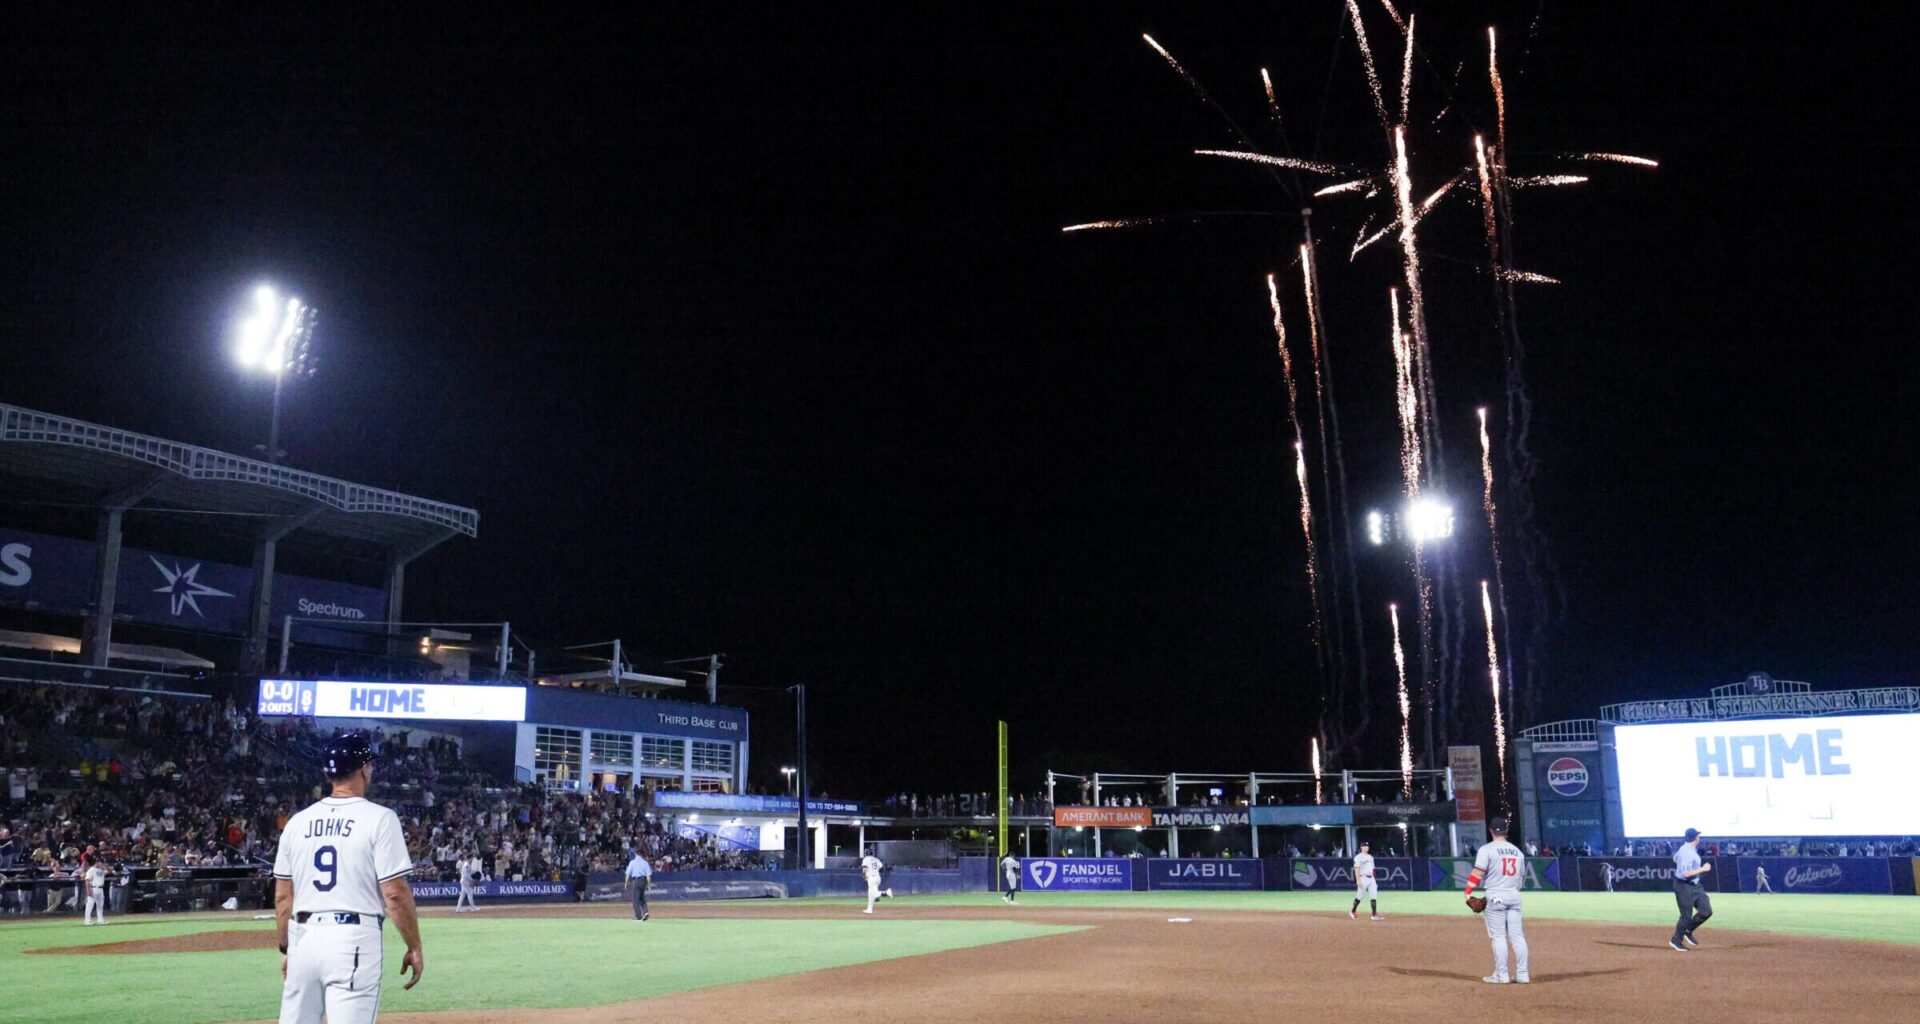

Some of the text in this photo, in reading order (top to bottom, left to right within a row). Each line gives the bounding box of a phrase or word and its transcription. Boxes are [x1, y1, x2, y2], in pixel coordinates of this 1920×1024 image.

[298, 598, 361, 618] Spectrum
[262, 682, 294, 700] 0-0
[301, 690, 312, 706] 8
[268, 703, 293, 713] OUTS
[350, 688, 426, 713] HOME
[1620, 701, 1688, 719] GEORGE
[1716, 692, 1859, 716] STEINBRENNER
[1861, 689, 1919, 708] FIELD
[657, 713, 738, 731] THIRD BASE CLUB
[1695, 729, 1851, 778] HOME
[1550, 772, 1587, 781] PEPSI
[1062, 811, 1145, 822] AMERANT BANK
[1153, 813, 1203, 825] TAMPA
[305, 818, 355, 838] JOHNS
[313, 845, 338, 891] 9
[1062, 864, 1123, 876] FANDUEL
[1169, 864, 1241, 877] JABIL
[1502, 858, 1516, 876] 13
[1784, 863, 1842, 888] Culver's
[412, 886, 459, 896] RAYMOND
[500, 885, 567, 895] RAYMOND JAMES
